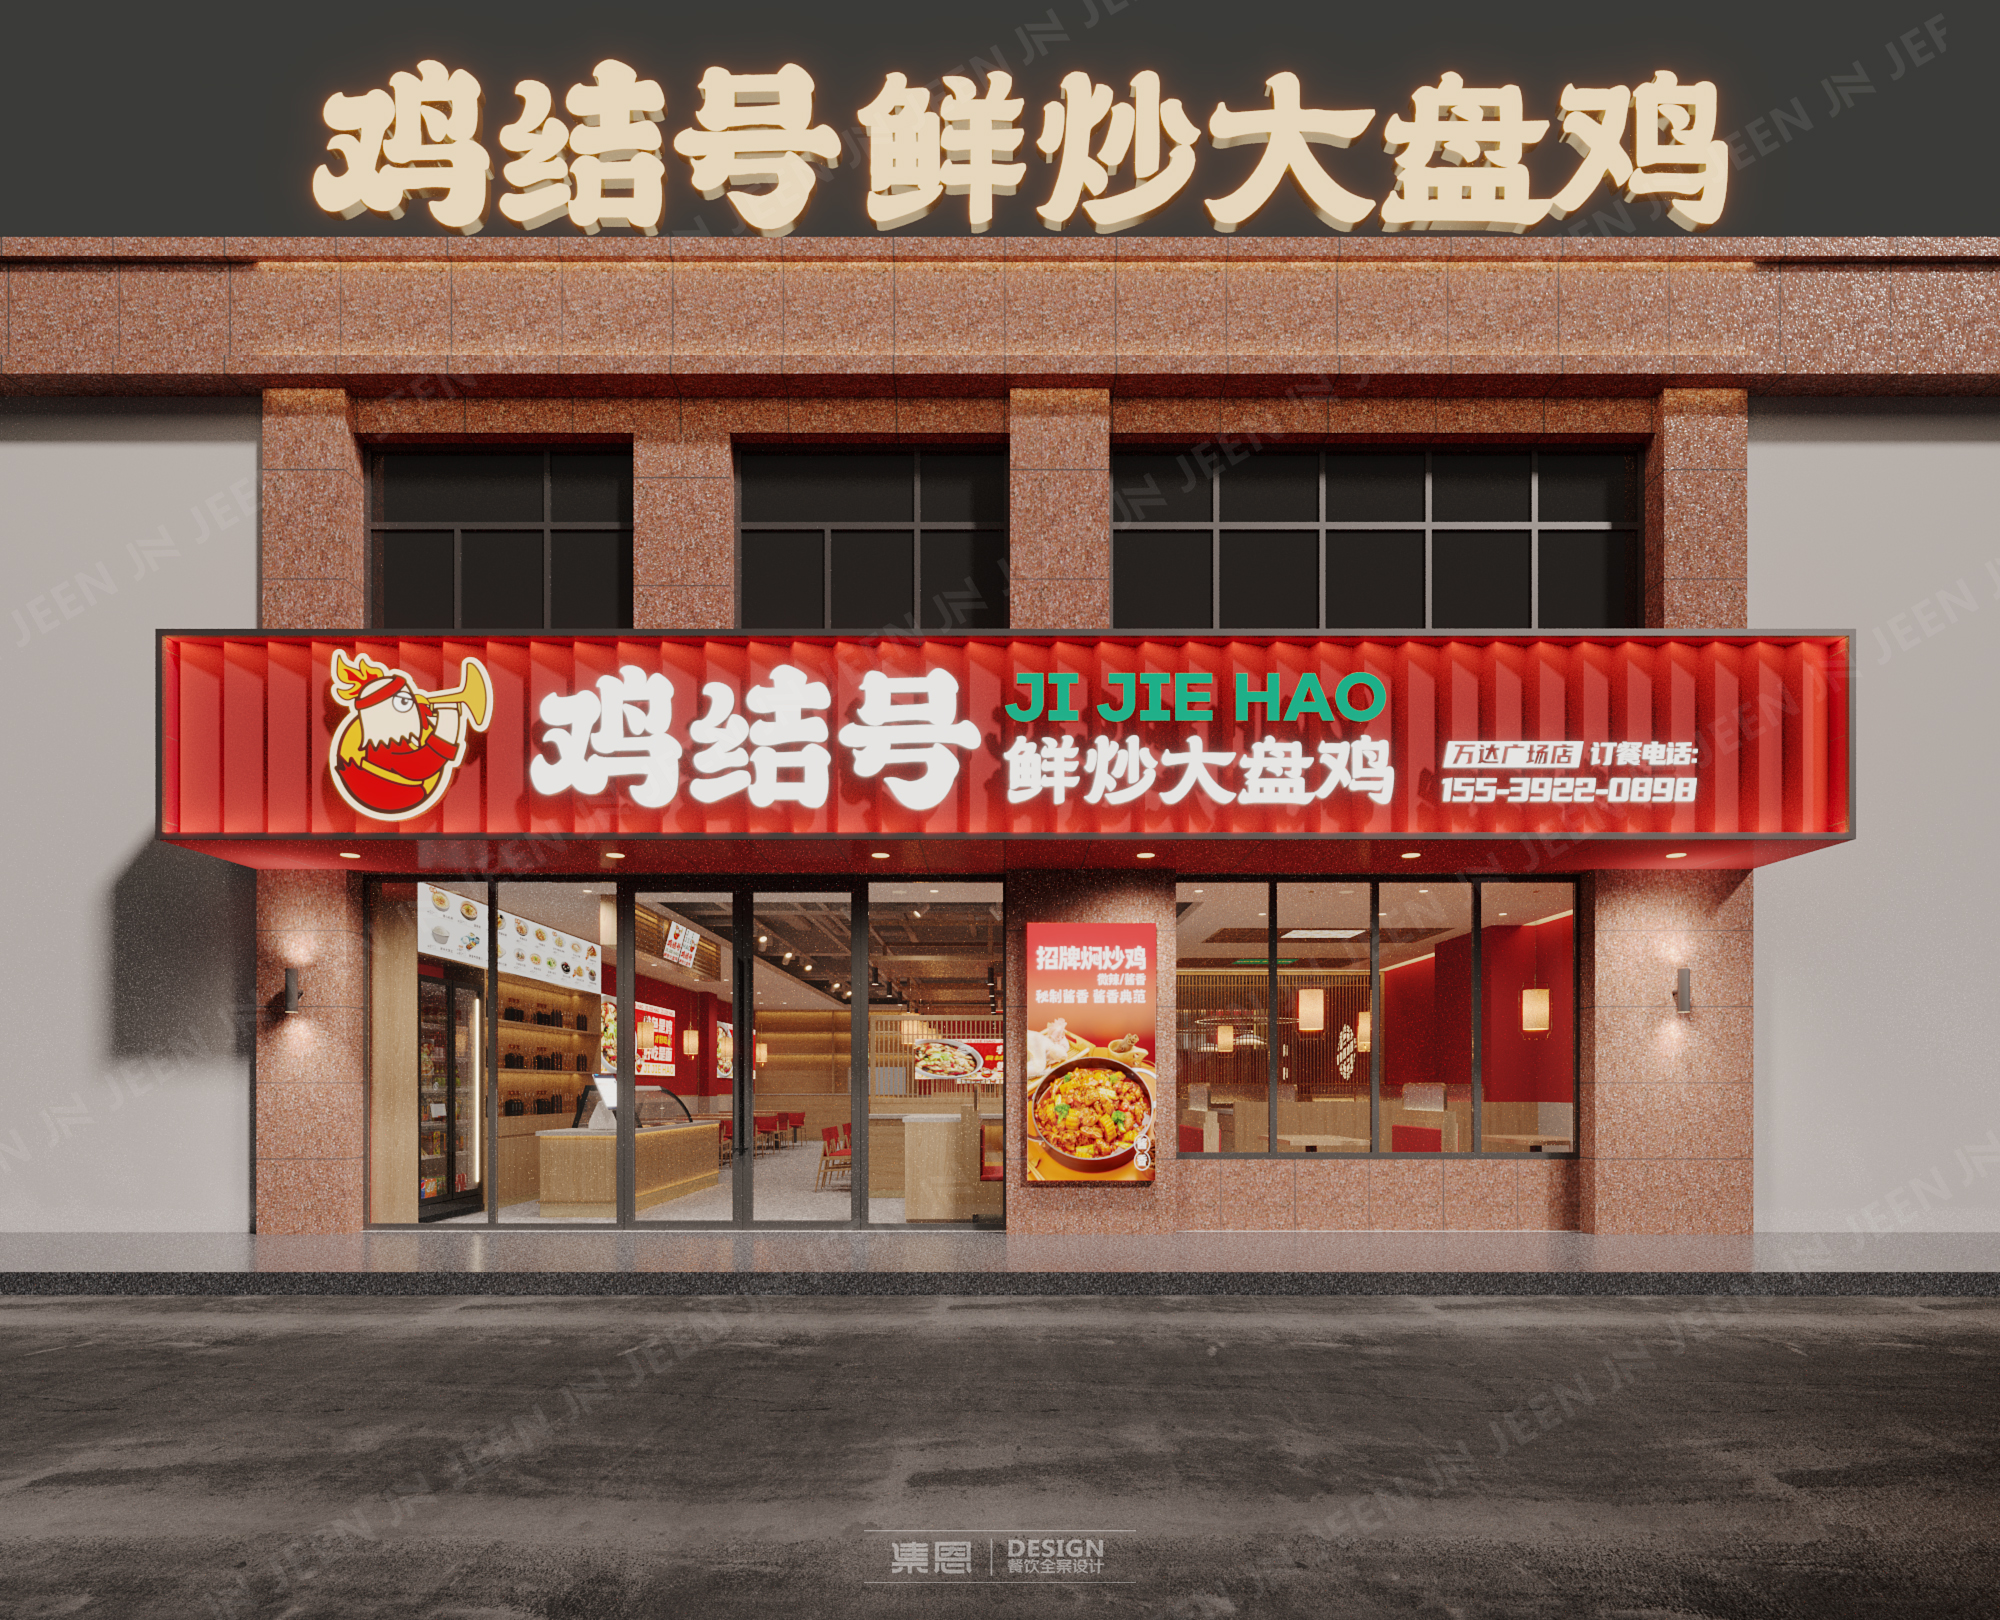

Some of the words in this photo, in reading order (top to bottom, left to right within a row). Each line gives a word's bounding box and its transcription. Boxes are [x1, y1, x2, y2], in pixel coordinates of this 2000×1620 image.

[312, 58, 1729, 235] 鸡结号鲜炒大盘鸡
[1004, 672, 1080, 722] JI
[1096, 672, 1214, 722] JIE
[1234, 671, 1387, 723] HAO
[529, 663, 983, 811] 鸡结号
[1452, 743, 1575, 765] 万达广场店
[1003, 735, 1395, 805] 鲜炒大盘鸡
[1441, 777, 1698, 803] 155-3922-0898
[1036, 945, 1147, 970] 招牌焖炒鸡
